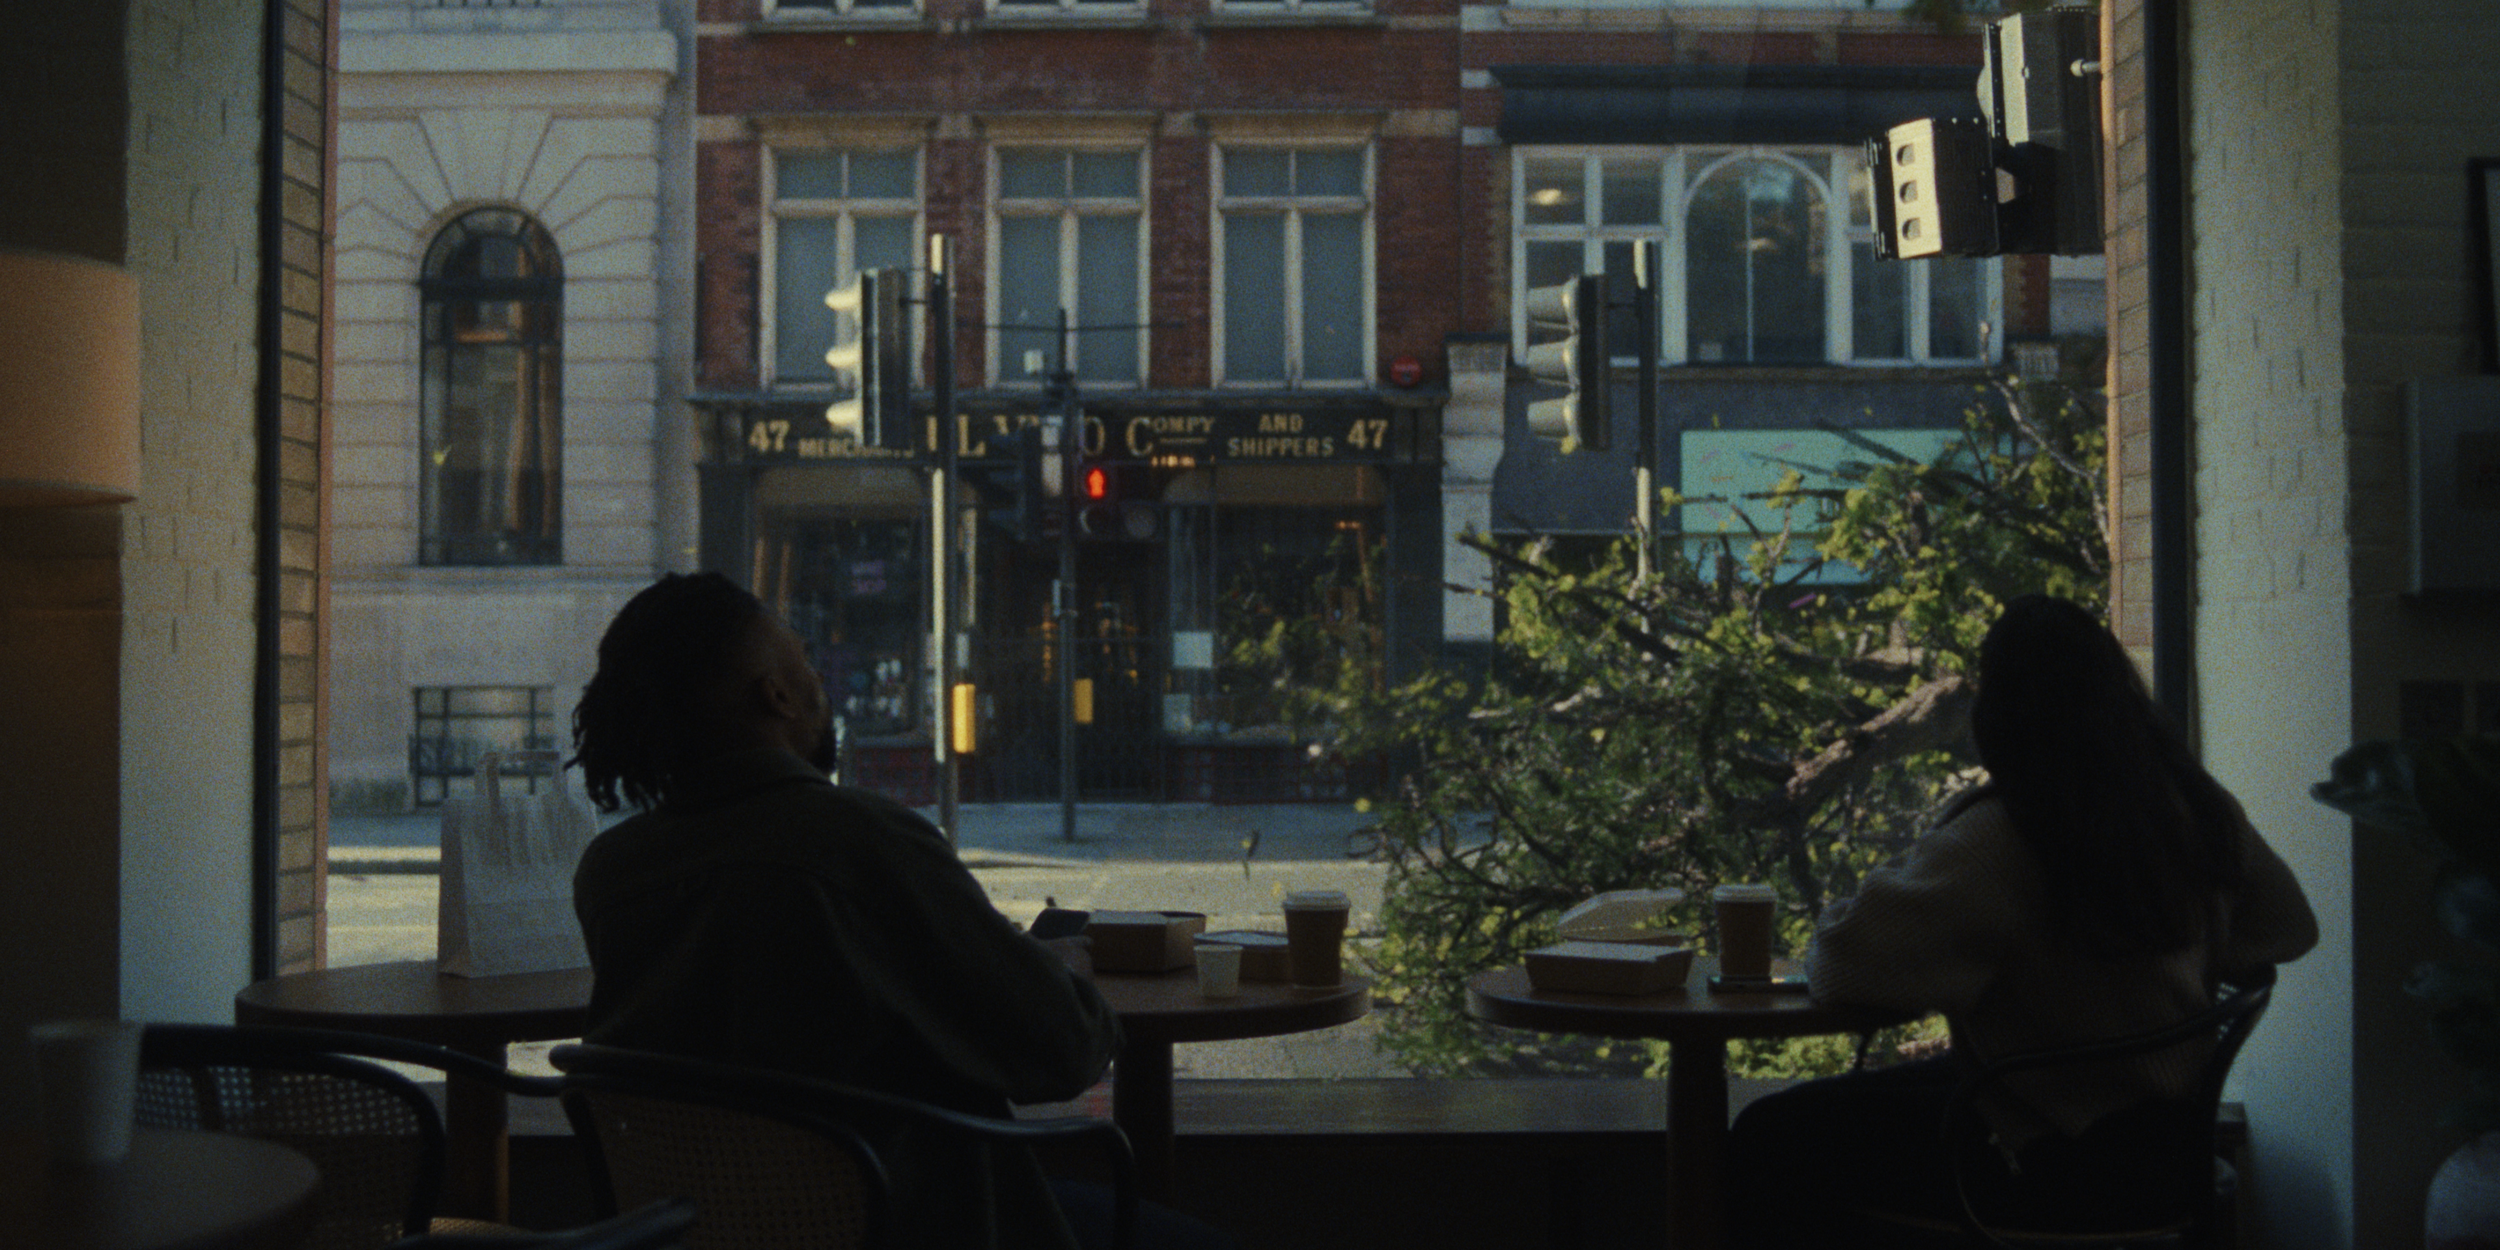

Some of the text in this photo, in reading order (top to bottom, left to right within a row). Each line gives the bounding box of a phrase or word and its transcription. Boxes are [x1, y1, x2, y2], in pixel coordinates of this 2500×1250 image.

[750, 420, 790, 451] 47
[1258, 414, 1304, 433] AND
[1346, 419, 1389, 449] 47
[1226, 437, 1335, 457] SHIPPERS
